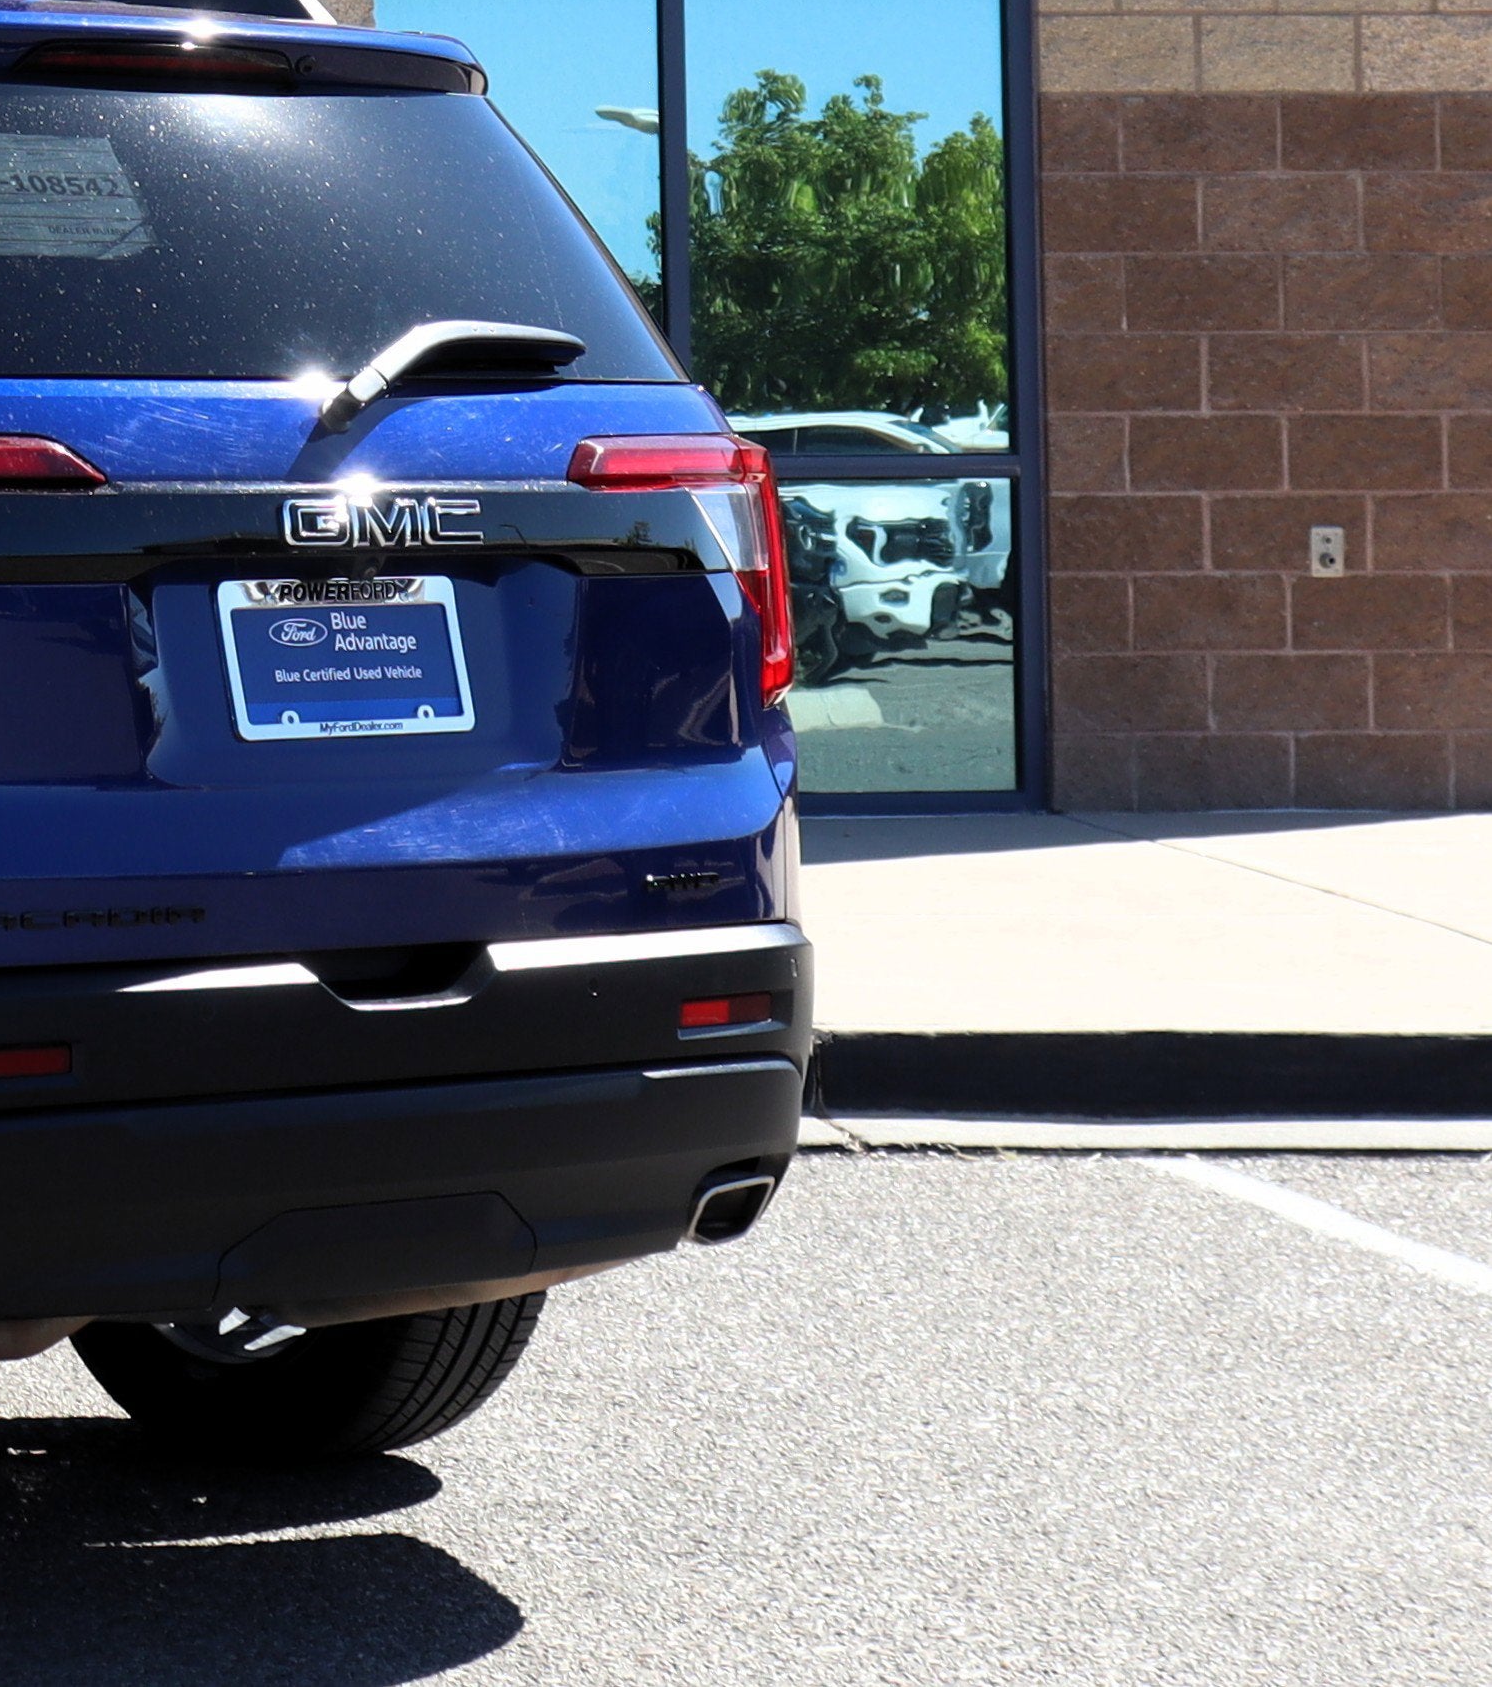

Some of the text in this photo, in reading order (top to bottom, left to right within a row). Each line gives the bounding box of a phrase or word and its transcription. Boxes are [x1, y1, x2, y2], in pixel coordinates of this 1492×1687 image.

[282, 497, 484, 548] GMC
[330, 611, 367, 630] Blue
[281, 622, 317, 642] Ford
[334, 633, 417, 654] Advantage
[275, 665, 423, 683] Blue Certified Used Vehicle
[319, 721, 404, 736] MyFordDealer.com
